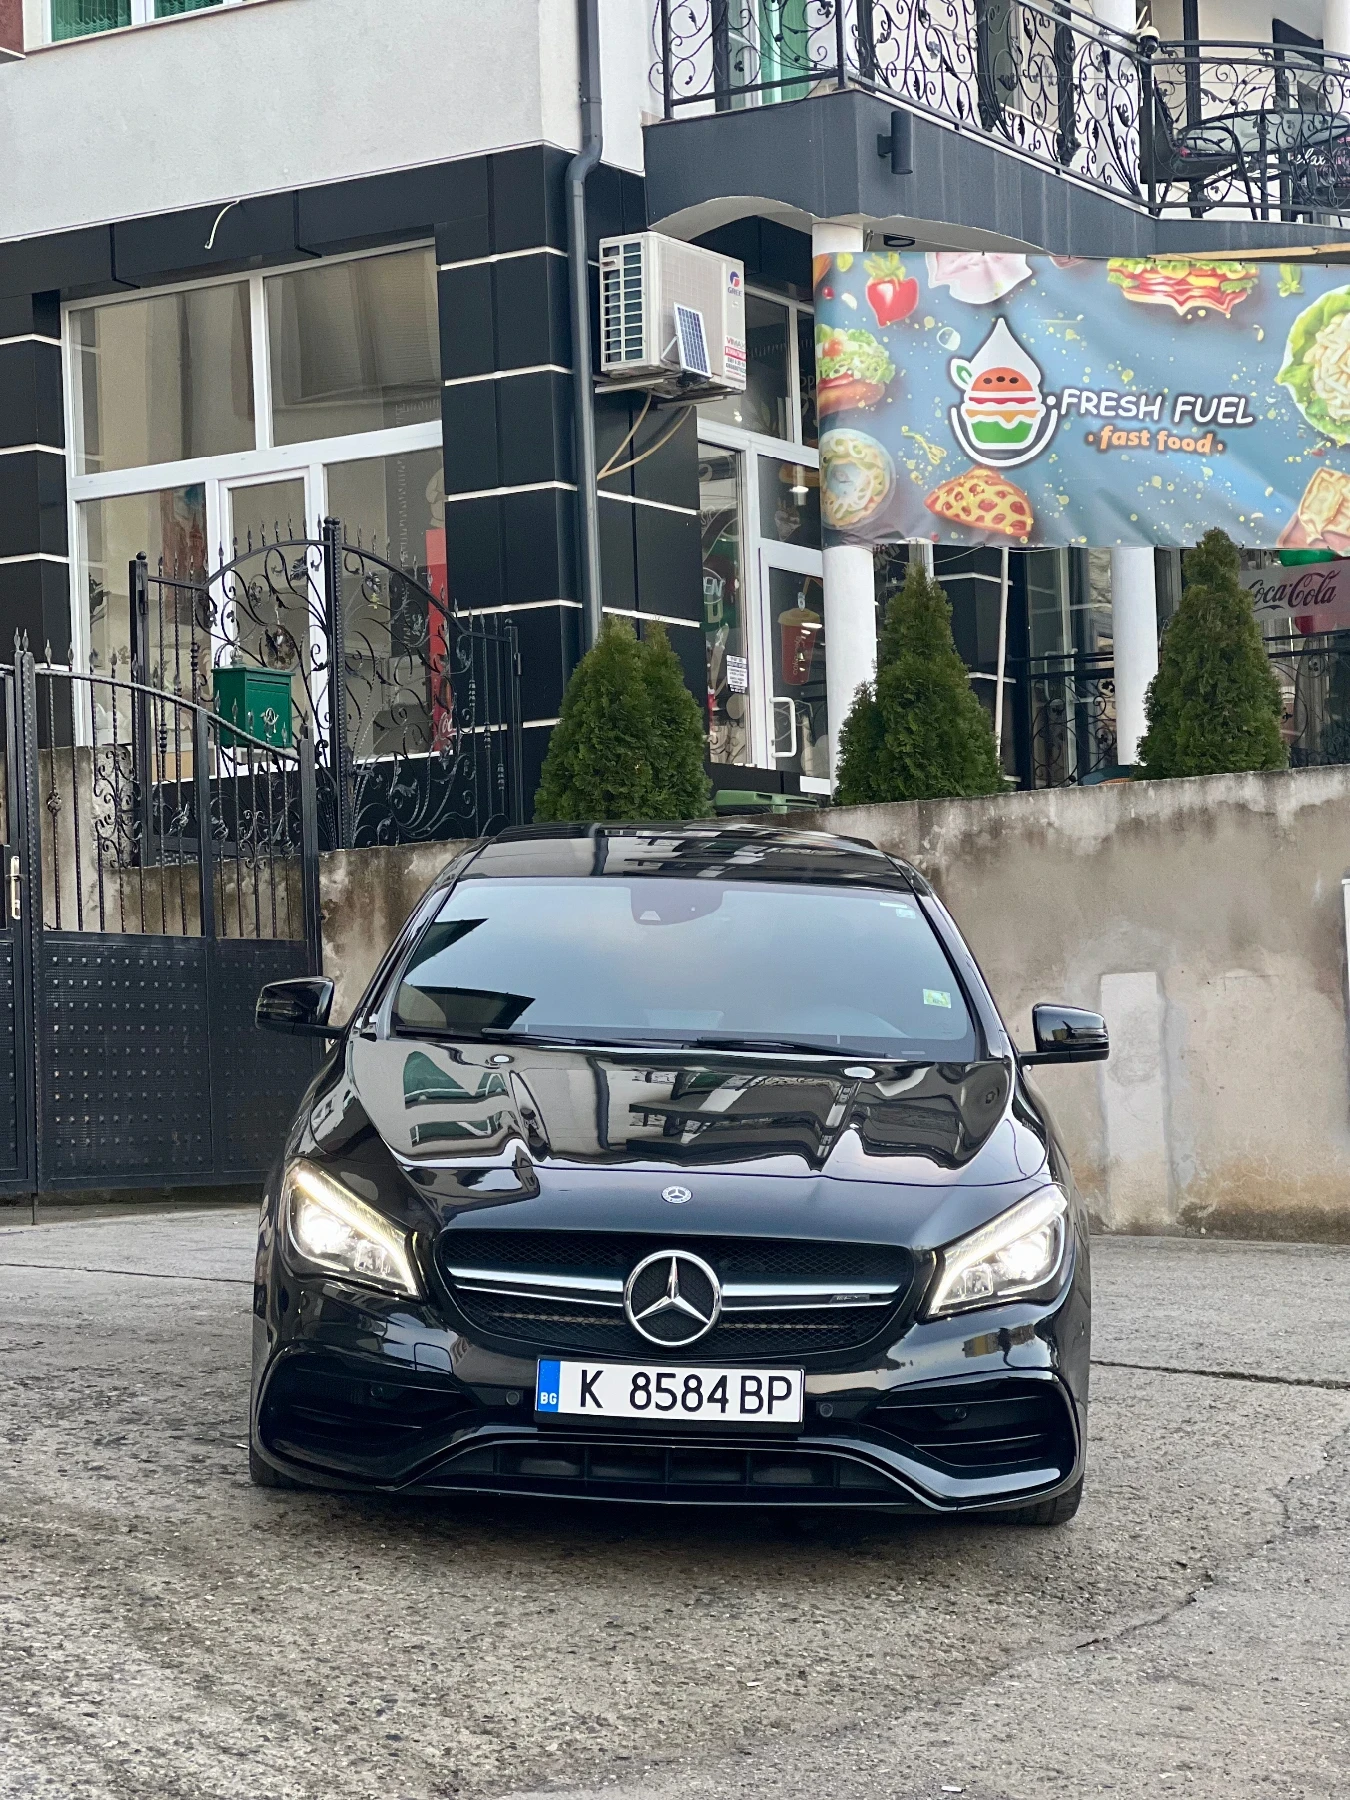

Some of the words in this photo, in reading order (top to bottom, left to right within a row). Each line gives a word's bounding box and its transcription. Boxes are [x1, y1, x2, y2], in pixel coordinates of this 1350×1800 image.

[1287, 147, 1326, 166] elax
[1060, 388, 1163, 421] FRESH
[1173, 395, 1254, 424] FUEL
[1099, 425, 1151, 450] fast
[1156, 430, 1214, 454] food
[540, 1392, 558, 1405] BG
[580, 1369, 604, 1409] K
[629, 1371, 730, 1415] 8584
[739, 1375, 793, 1415] BP
